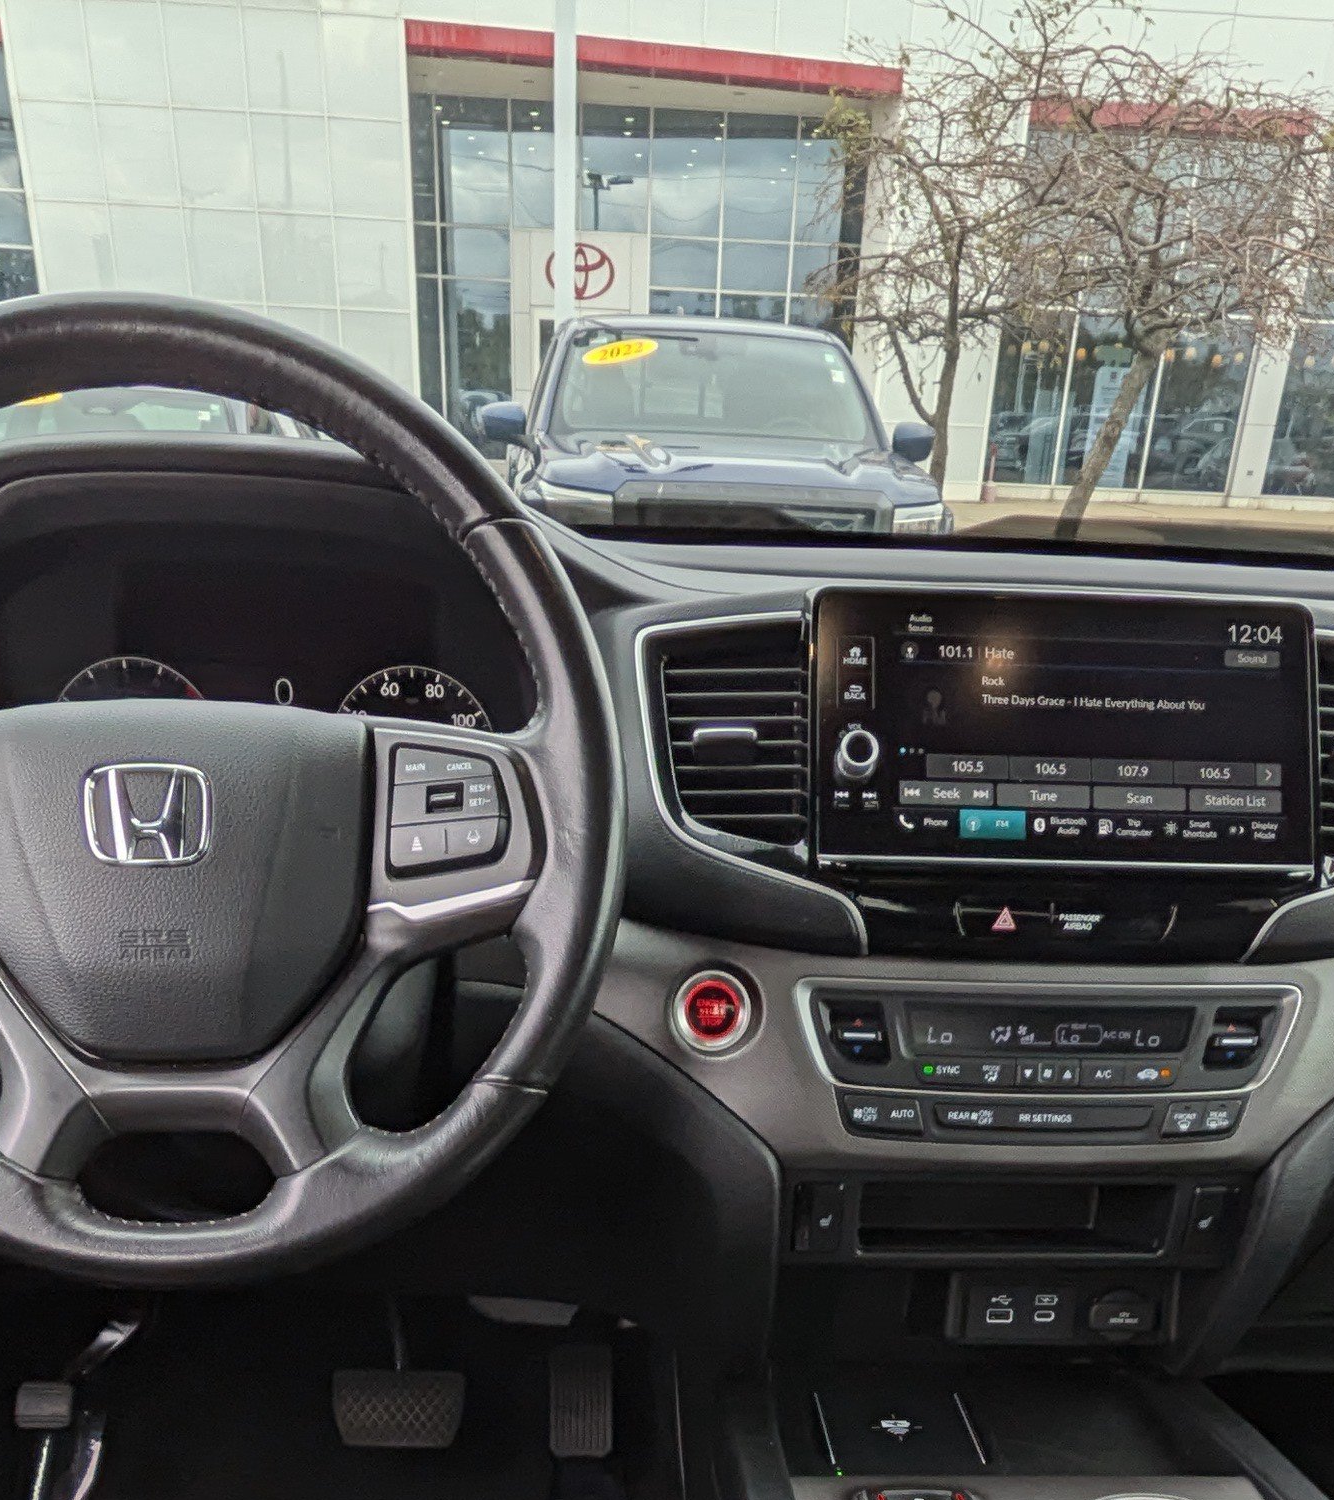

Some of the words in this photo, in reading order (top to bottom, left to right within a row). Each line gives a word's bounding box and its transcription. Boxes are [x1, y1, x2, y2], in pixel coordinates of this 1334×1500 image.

[1228, 624, 1283, 644] 12:04
[938, 645, 973, 658] 101.1
[985, 646, 1015, 660] Hate
[843, 657, 867, 665] HOME
[1237, 653, 1267, 664] Sound
[981, 676, 1005, 686] Rock
[275, 677, 293, 706] 0
[380, 682, 400, 696] 60
[425, 683, 445, 698] 80
[844, 692, 866, 700] BACK
[982, 694, 1009, 705] Three
[1011, 694, 1035, 707] Days
[1037, 696, 1065, 707] Grace
[1080, 698, 1102, 708] Hate
[1105, 698, 1155, 712] Everything
[1157, 699, 1185, 710] About
[1187, 700, 1206, 711] You
[451, 713, 477, 728] 100
[405, 763, 426, 771] MAIN
[447, 762, 472, 771] CANCEL
[952, 761, 984, 773] 105.5
[1035, 763, 1067, 775] 106.5
[1118, 765, 1149, 777] 107.9
[1200, 767, 1231, 780] 106.5
[933, 787, 961, 799] Seek
[1030, 789, 1057, 802] Tune
[1127, 792, 1153, 804] Scan
[1205, 794, 1244, 806] Station
[1247, 795, 1266, 807] List
[923, 817, 948, 828] Phone
[1050, 817, 1087, 826] Bluetooth
[1189, 820, 1210, 829] Smart
[1251, 821, 1278, 831] Display
[1057, 827, 1080, 835] Audio
[1115, 828, 1153, 837] Computer
[1182, 830, 1218, 839] Shortcuts
[1254, 831, 1276, 839] Mode
[936, 1065, 961, 1075] SYNC
[1095, 1069, 1112, 1079] A/C
[890, 1109, 915, 1119] AUTO
[948, 1111, 970, 1121] REAR
[1032, 1113, 1072, 1123] SETTINGS
